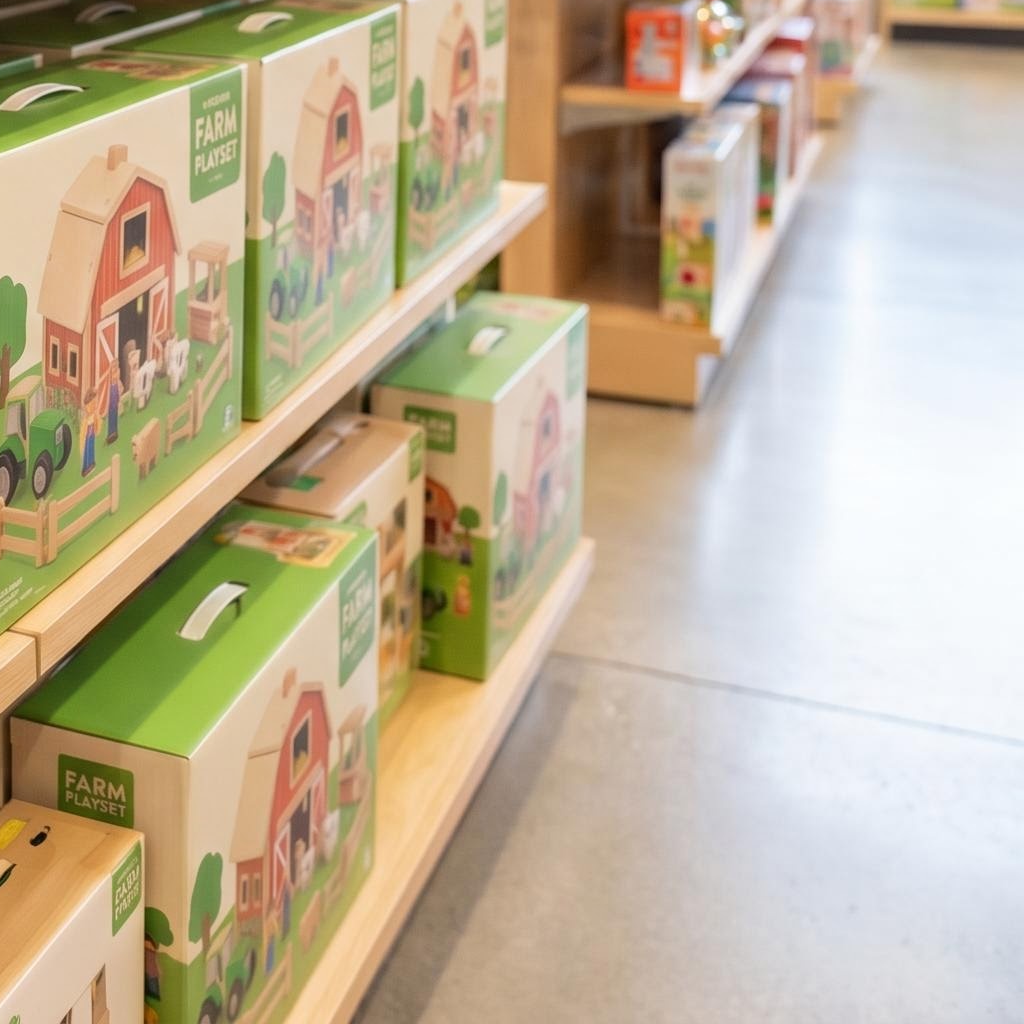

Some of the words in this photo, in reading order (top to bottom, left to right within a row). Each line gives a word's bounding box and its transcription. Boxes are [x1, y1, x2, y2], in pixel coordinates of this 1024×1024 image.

[195, 103, 237, 150] FARM
[195, 138, 238, 177] PLAYSET
[65, 769, 127, 803] FARM
[65, 790, 127, 818] PLAYSET
